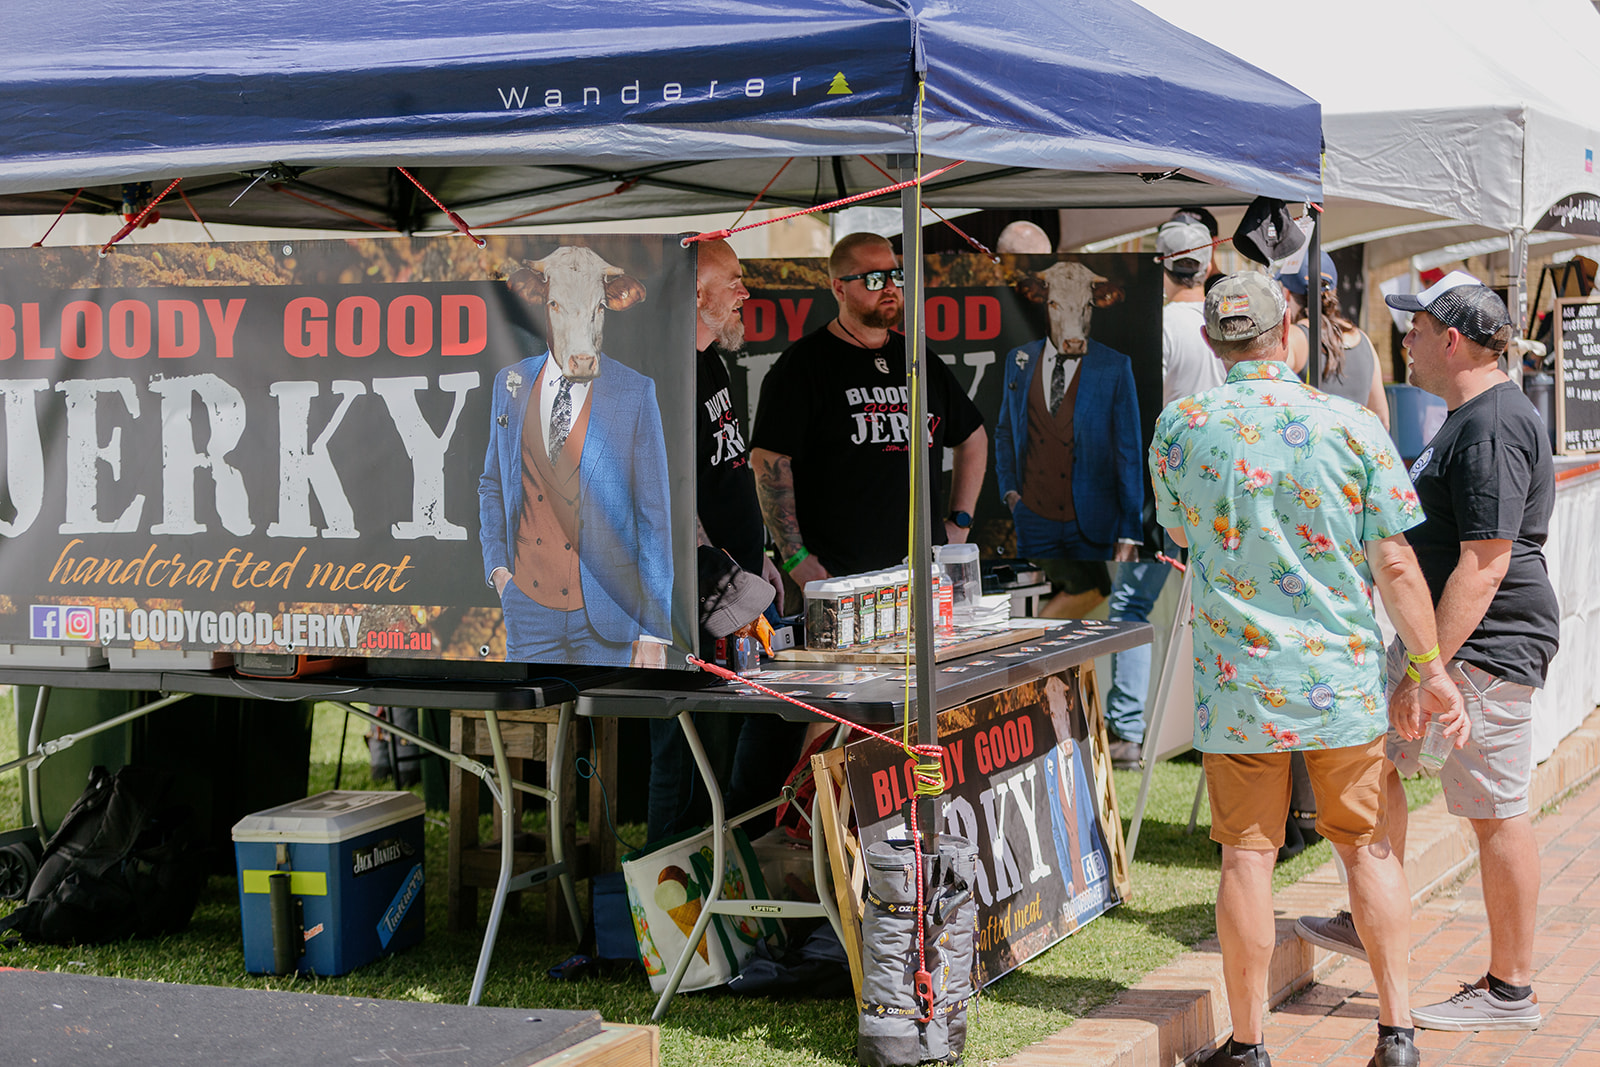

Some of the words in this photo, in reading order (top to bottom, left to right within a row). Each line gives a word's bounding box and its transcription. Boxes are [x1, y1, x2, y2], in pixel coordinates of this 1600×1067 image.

[283, 294, 487, 358] GOOD
[845, 386, 908, 406] BLOOD
[0, 371, 480, 541] JERKY
[48, 538, 307, 592] handcrafted
[306, 555, 415, 593] meat
[872, 739, 966, 819] BLODY
[974, 715, 1035, 775] GOOD
[887, 763, 1052, 908] RKY
[1013, 892, 1043, 932] meat
